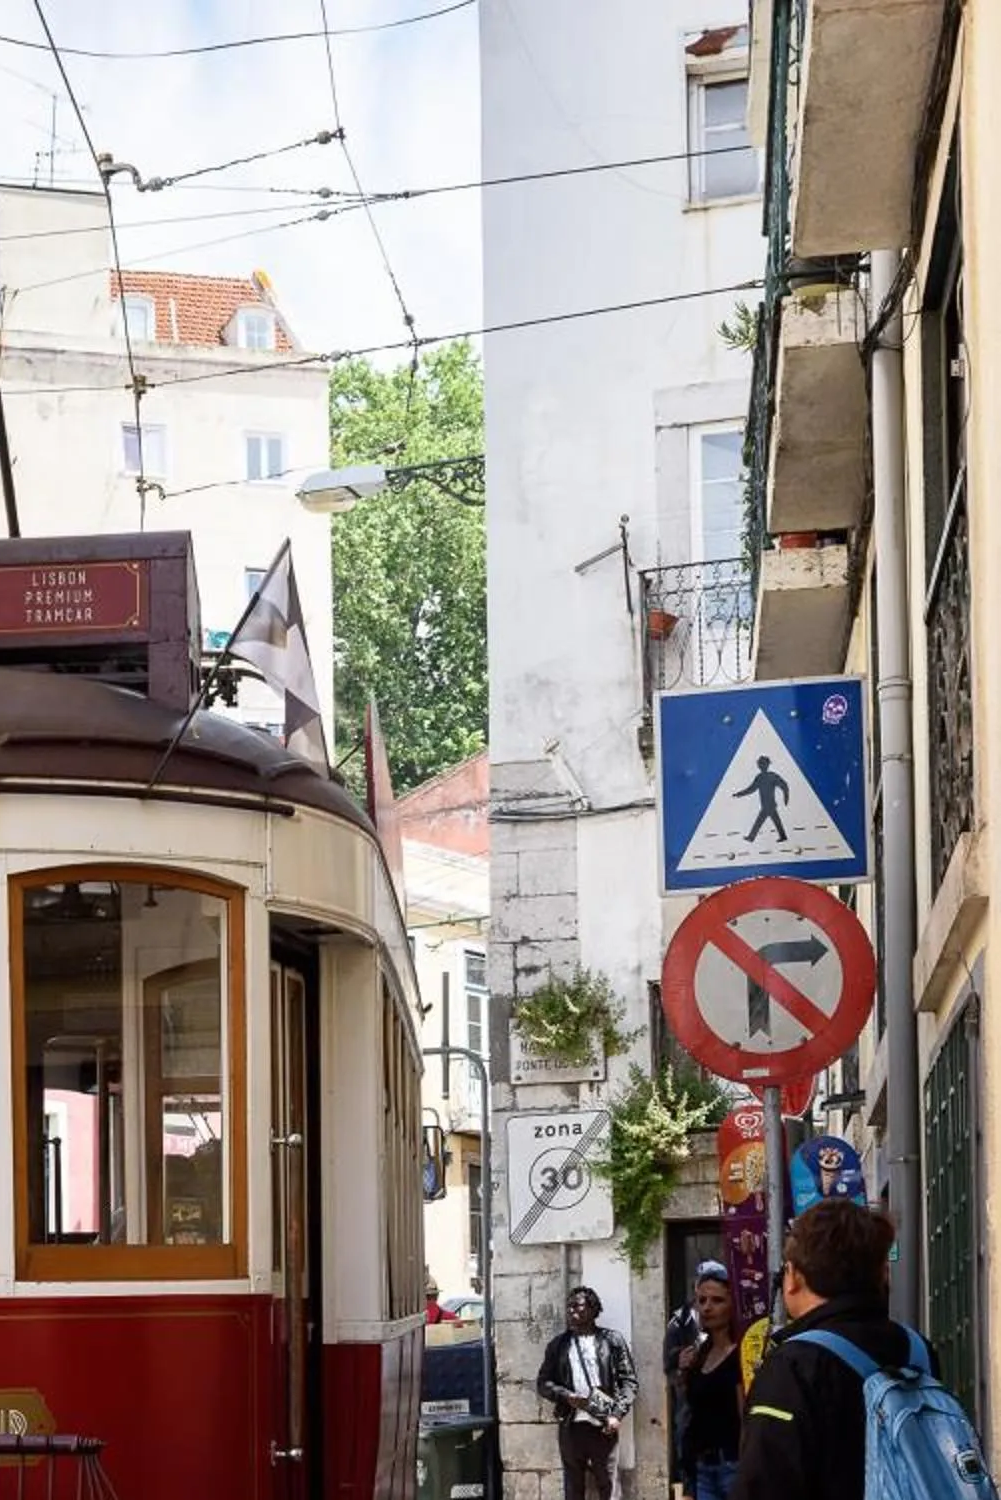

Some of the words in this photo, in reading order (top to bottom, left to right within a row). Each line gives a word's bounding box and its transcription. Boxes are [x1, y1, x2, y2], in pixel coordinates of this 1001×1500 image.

[31, 570, 86, 587] LISBON
[24, 588, 93, 605] PREMIUM
[25, 607, 93, 623] TRAMCAR
[534, 1123, 584, 1138] zona
[540, 1163, 584, 1192] 30
